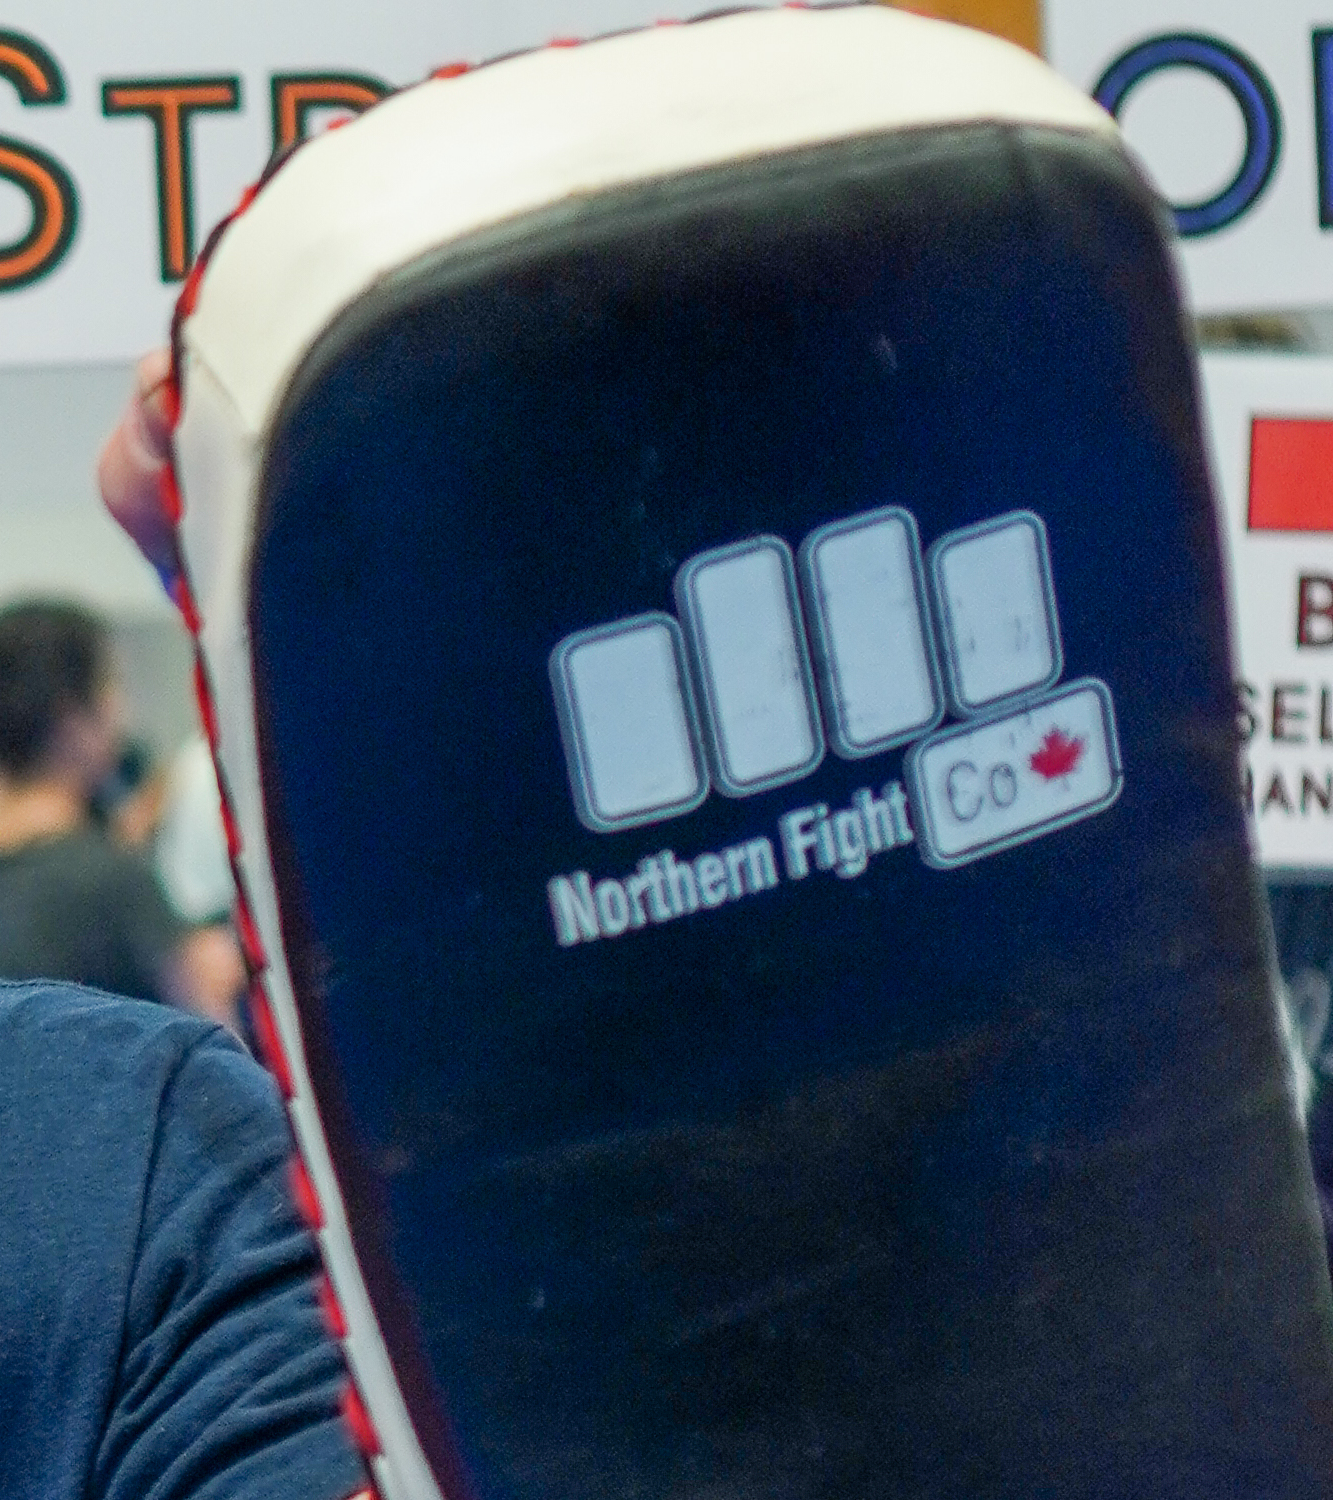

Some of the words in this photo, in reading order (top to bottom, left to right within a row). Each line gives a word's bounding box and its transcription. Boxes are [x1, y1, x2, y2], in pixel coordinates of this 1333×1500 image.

[547, 836, 779, 947] Northern
[779, 780, 916, 879] Fight
[945, 759, 1018, 822] Co
